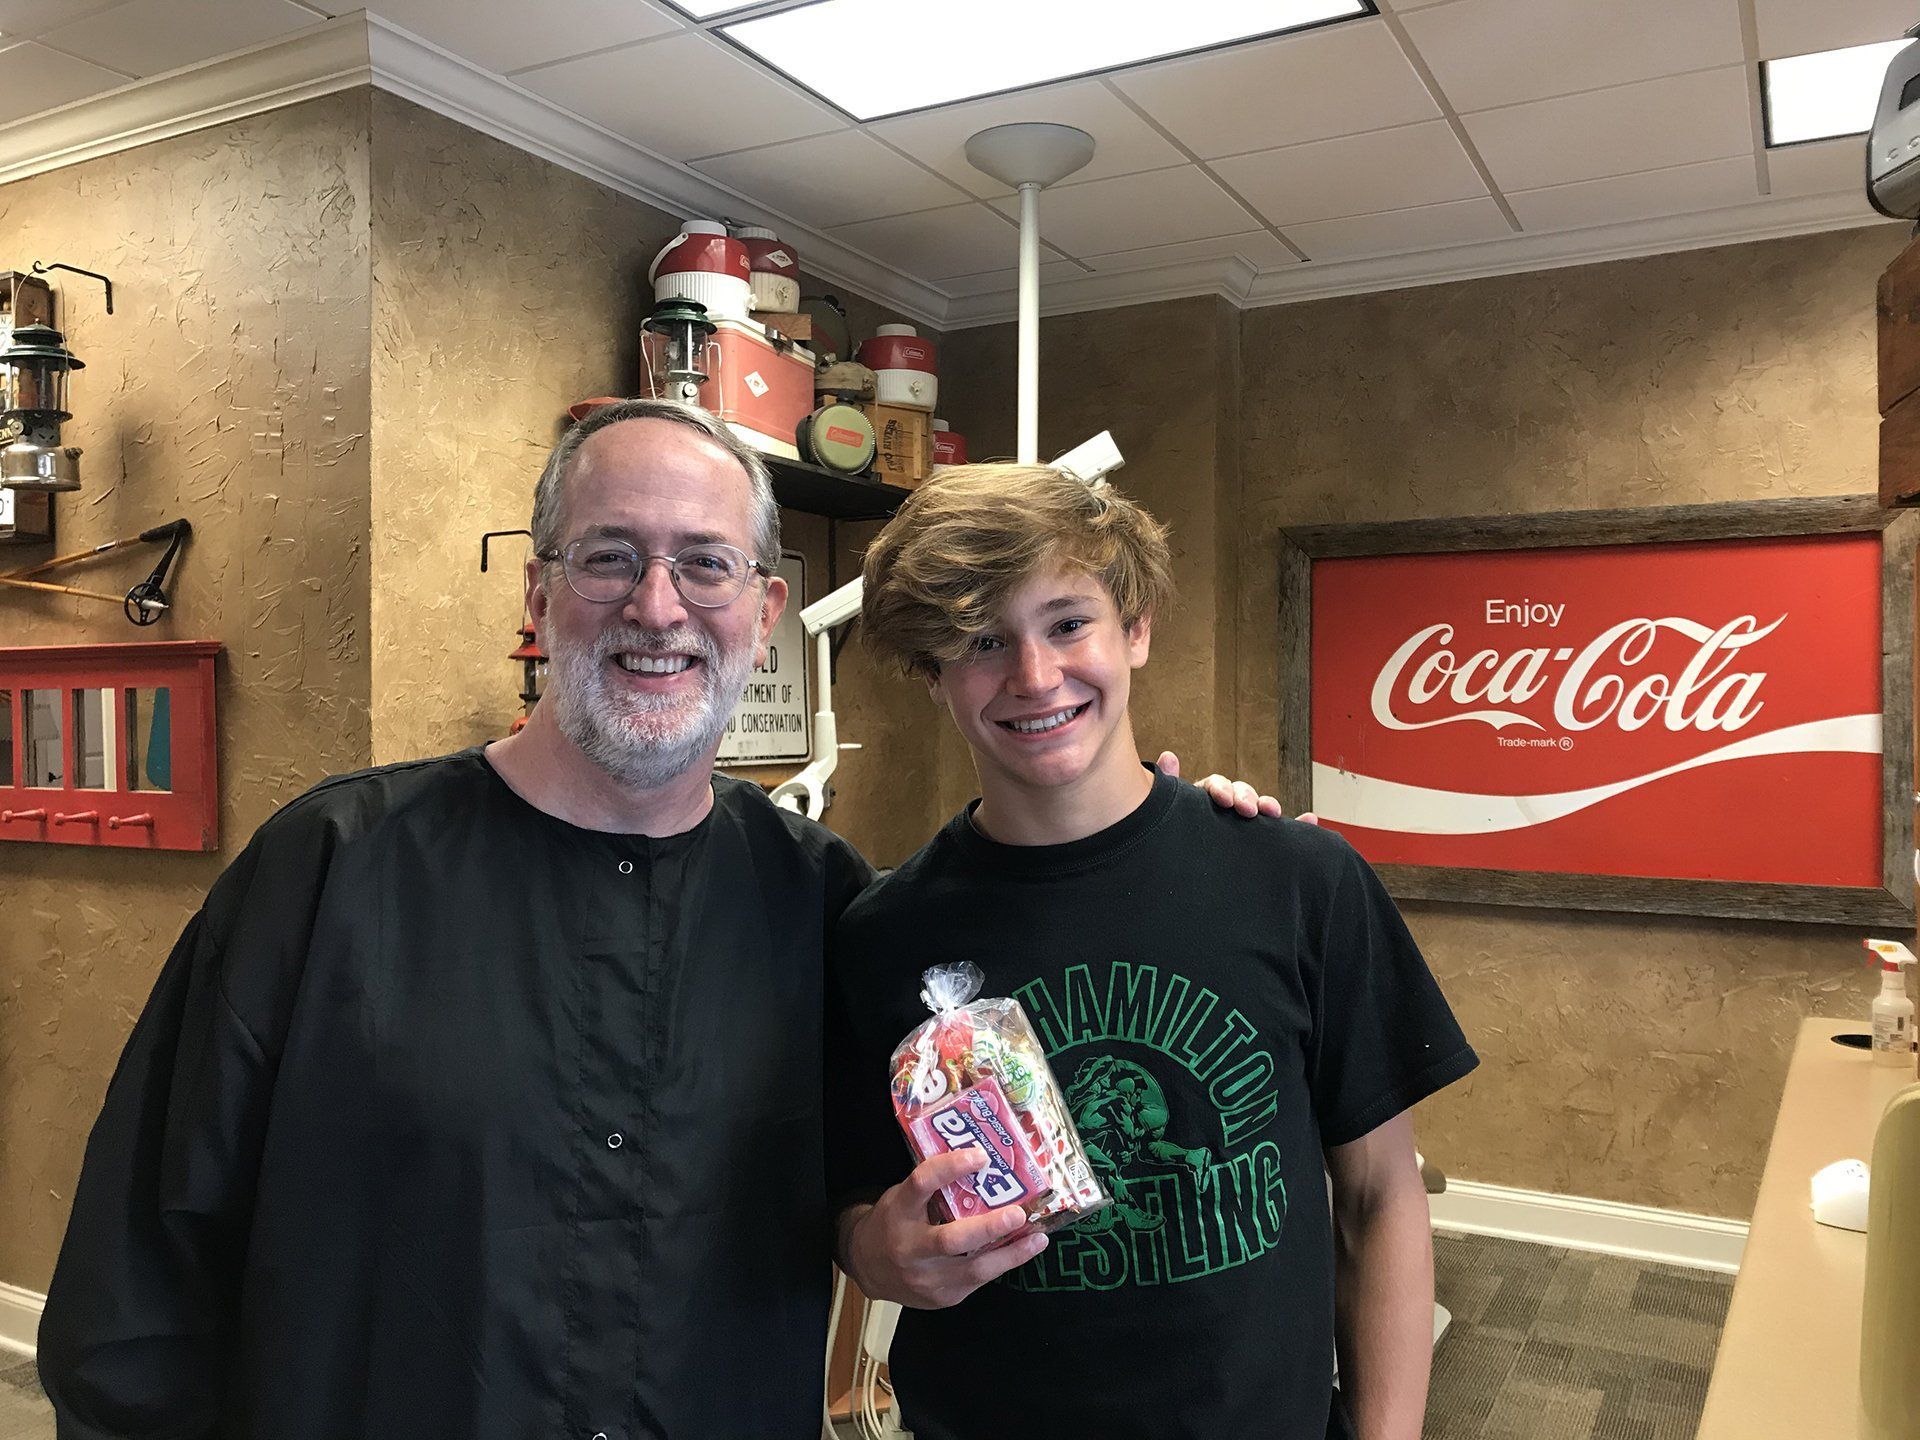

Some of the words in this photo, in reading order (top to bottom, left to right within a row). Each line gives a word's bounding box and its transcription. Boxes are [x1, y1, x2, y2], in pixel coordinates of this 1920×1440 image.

[1486, 599, 1566, 628] Enjoy
[1371, 612, 1789, 732] Coca-Cola
[741, 683, 776, 703] RTMENT
[782, 684, 792, 704] OF
[726, 716, 736, 733] ND
[742, 713, 802, 733] CONSERVATION
[1497, 737, 1557, 747] Trade-mark
[1011, 961, 1279, 1148] HAMILTON
[961, 1110, 982, 1135] FLAVOR
[977, 1132, 998, 1157] LASTING
[932, 1108, 1025, 1208] Exra
